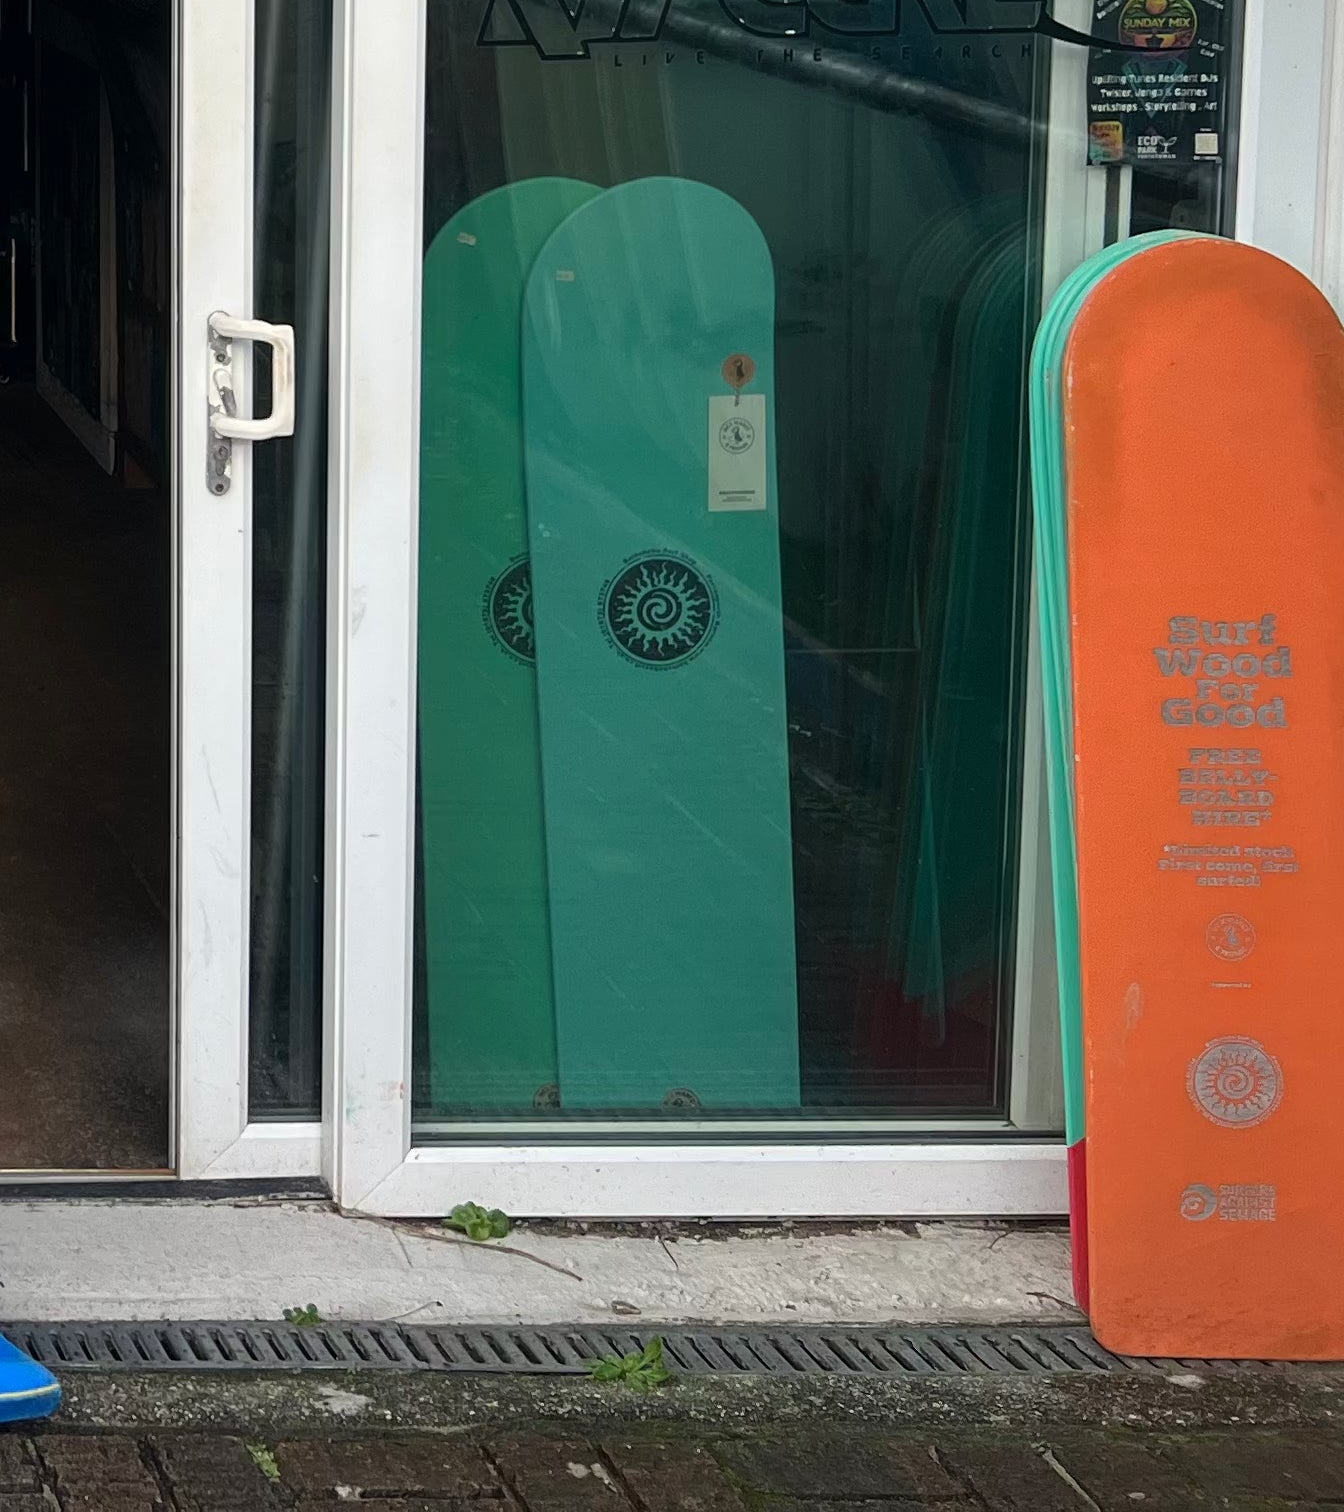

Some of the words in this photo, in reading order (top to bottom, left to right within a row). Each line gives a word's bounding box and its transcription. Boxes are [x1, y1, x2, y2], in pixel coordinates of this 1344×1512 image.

[1123, 17, 1166, 30] SUNDAY
[1168, 17, 1191, 28] MIX
[614, 51, 708, 68] LIVE
[1137, 136, 1158, 146] ECO
[1168, 613, 1277, 646] Surf
[1153, 646, 1294, 678] Wood
[1195, 678, 1260, 701] For
[1161, 696, 1289, 729] Good
[1189, 747, 1263, 765] FREE
[1178, 768, 1279, 786] BELLY-
[1178, 789, 1275, 807] BOARD
